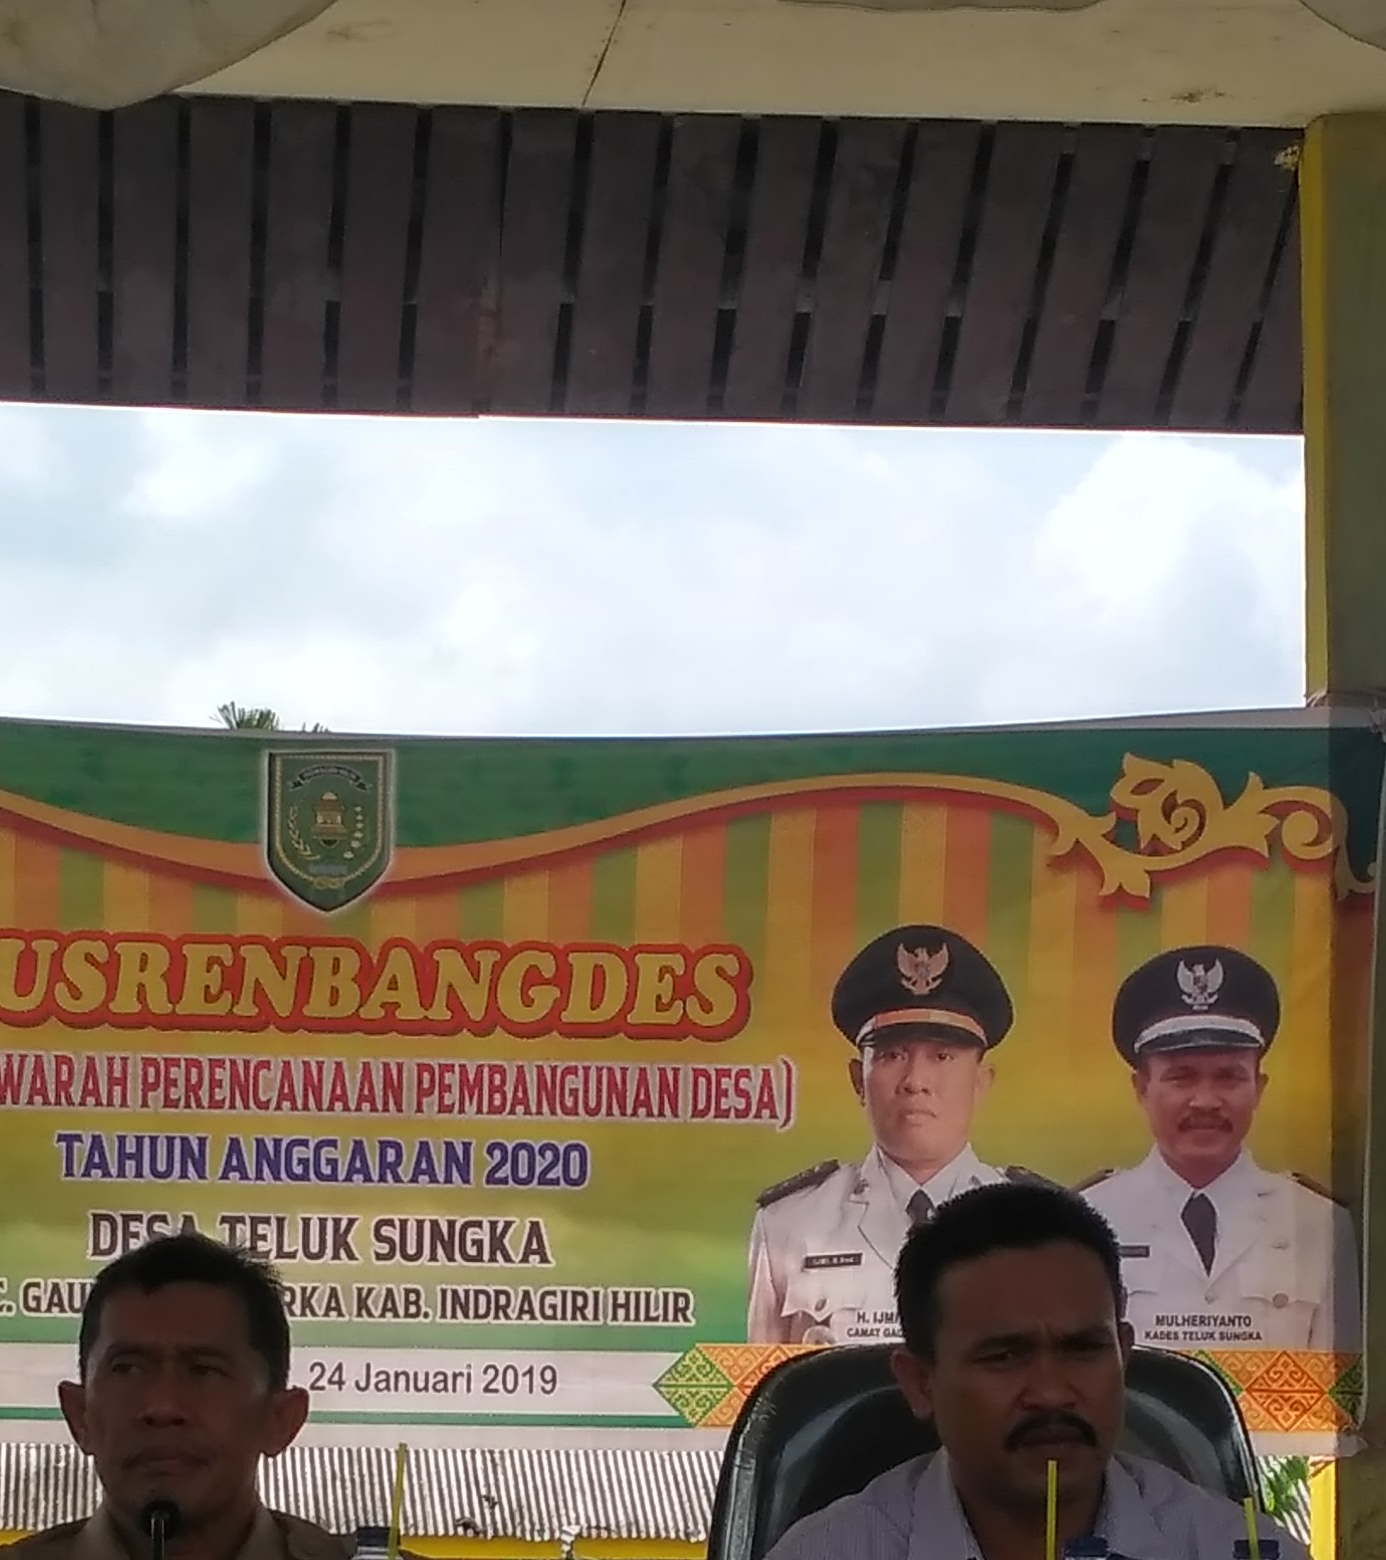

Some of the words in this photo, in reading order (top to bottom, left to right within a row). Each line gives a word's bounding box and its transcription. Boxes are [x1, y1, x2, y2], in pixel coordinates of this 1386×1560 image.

[139, 1054, 406, 1115] PERENCANAAN
[413, 1060, 681, 1120] PEMBANGUNAN
[55, 1130, 210, 1181] TAHUN
[218, 1135, 473, 1187] ANGGARAN
[483, 1141, 590, 1188] 2020
[217, 1214, 361, 1261] TELUK
[372, 1217, 553, 1265] SUNGKA
[22, 1281, 92, 1314] GAU
[283, 1284, 347, 1318] RKA
[354, 1285, 431, 1320] KAB.
[438, 1288, 603, 1322] INDRAGIRI
[611, 1291, 694, 1324] HILIR
[856, 1311, 870, 1324] H.
[1154, 1314, 1253, 1328] MULHERIYANTO
[1144, 1330, 1180, 1341] KADES
[1181, 1331, 1217, 1342] TELUK
[308, 1361, 346, 1392] 24
[354, 1362, 472, 1394] Januari
[482, 1363, 558, 1395] 2019
